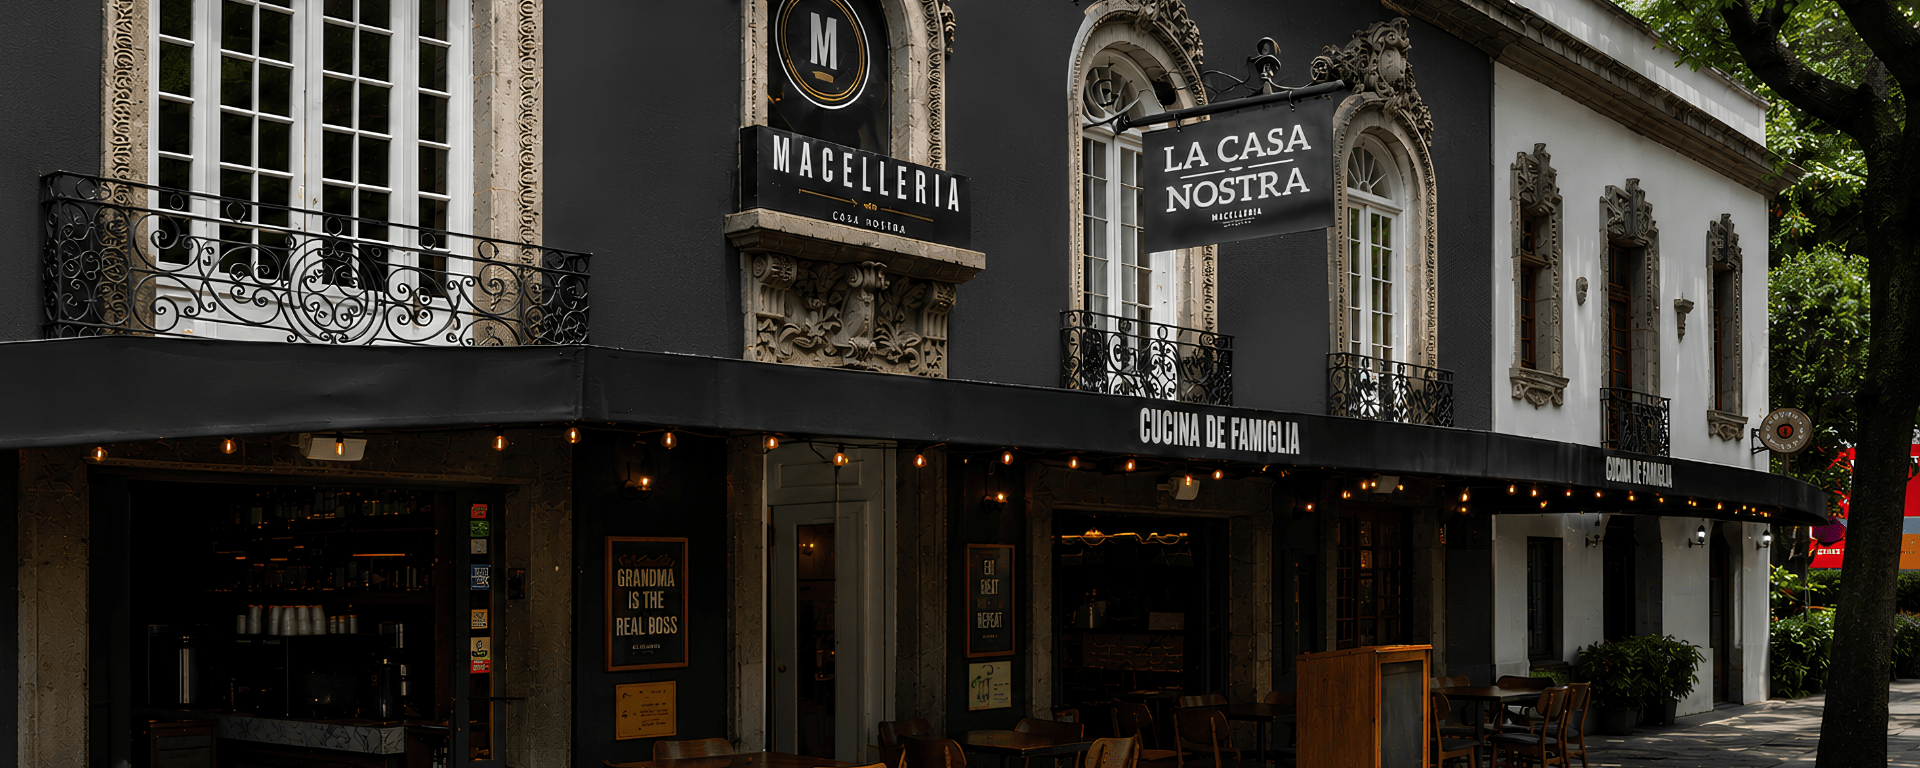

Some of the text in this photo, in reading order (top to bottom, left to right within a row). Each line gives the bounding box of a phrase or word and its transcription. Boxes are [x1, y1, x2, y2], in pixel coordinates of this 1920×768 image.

[810, 11, 837, 70] M
[1163, 124, 1312, 173] LA CASA
[773, 134, 960, 212] MACELLERIA
[1165, 167, 1311, 213] NOSTRA
[1139, 407, 1301, 455] CUCINA DE FAMIGLIA
[617, 567, 675, 588] GRANDMA
[628, 590, 665, 609] IS THE
[616, 615, 678, 637] REAL BOSS
